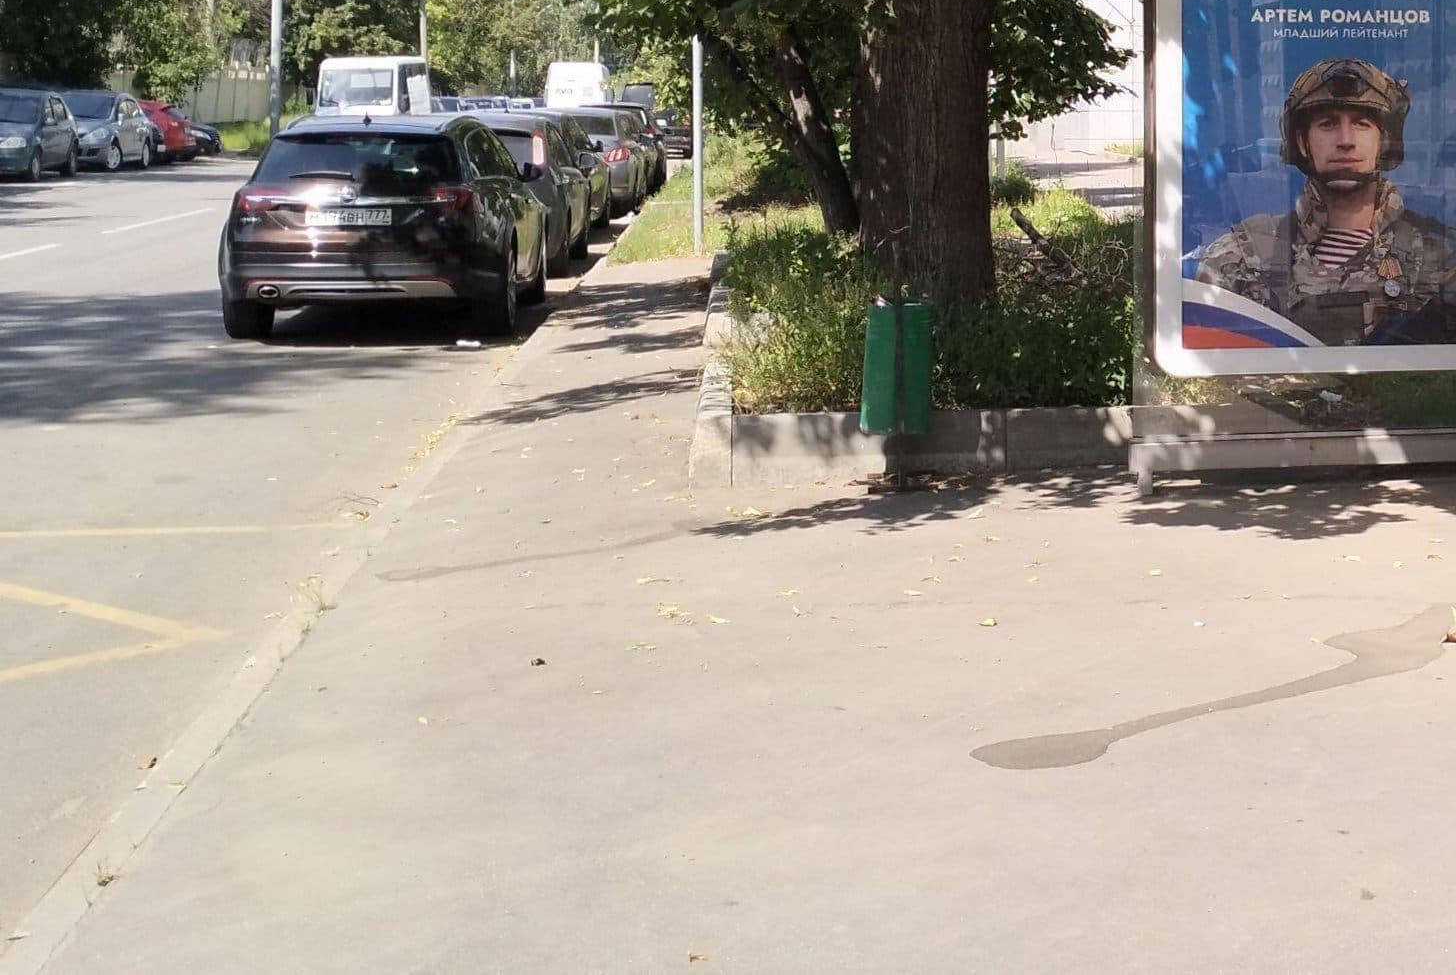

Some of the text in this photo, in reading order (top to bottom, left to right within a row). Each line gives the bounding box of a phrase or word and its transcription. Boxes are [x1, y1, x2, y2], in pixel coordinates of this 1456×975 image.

[1250, 8, 1431, 26] АРТЕМ РОМАНЦОВ
[1273, 25, 1409, 39] МЛАДШИЙ ЛЕЙТЕНАНТ
